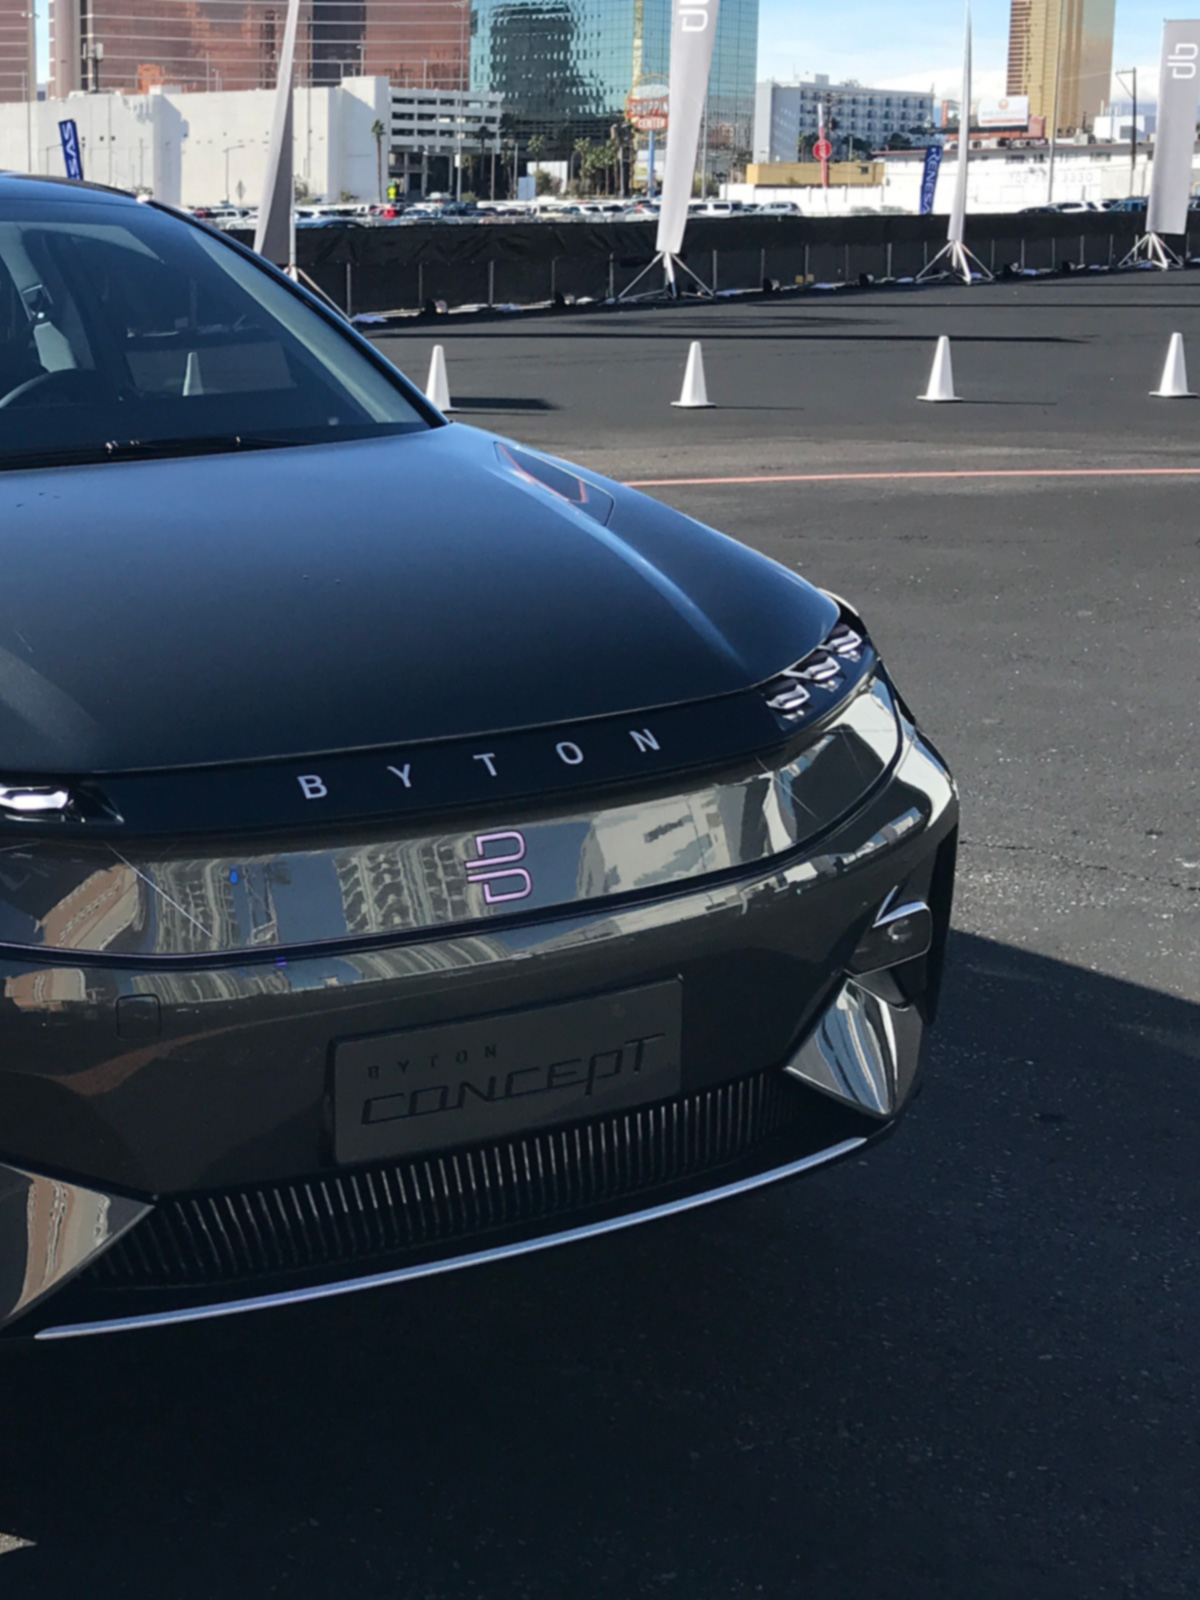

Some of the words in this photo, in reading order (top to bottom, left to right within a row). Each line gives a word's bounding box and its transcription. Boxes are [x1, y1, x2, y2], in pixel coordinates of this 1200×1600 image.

[629, 101, 669, 115] SHOPPIN
[921, 148, 941, 214] RENESA
[298, 728, 660, 800] BYTON
[361, 1033, 666, 1125] CONCEPT
[368, 1045, 497, 1079] BYTON
